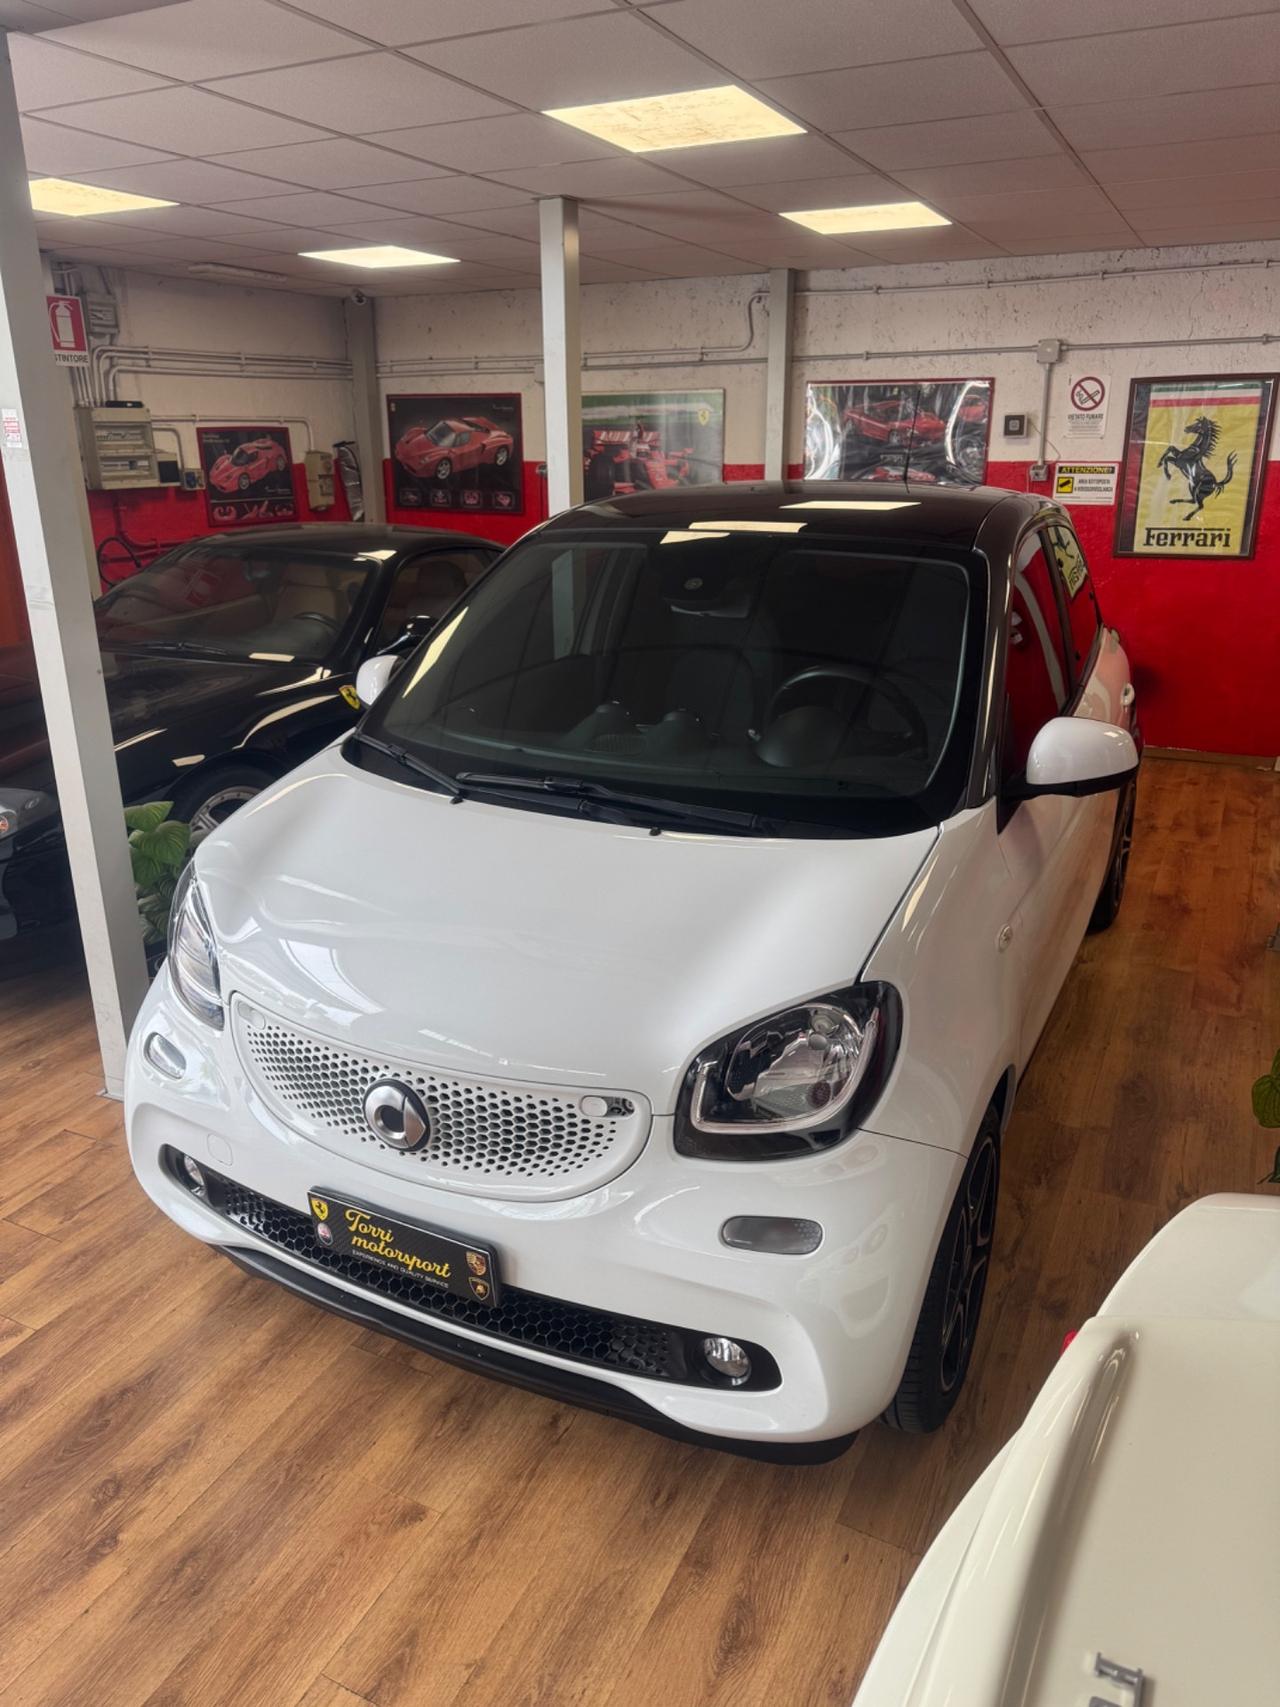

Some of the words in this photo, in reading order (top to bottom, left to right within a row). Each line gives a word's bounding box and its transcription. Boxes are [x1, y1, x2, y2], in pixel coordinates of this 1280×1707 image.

[1143, 527, 1231, 548] Ferrari
[345, 1209, 394, 1243] Torri
[351, 1235, 451, 1278] motorsport
[352, 1249, 386, 1266] EXPERIENCE
[387, 1260, 399, 1271] AND
[400, 1266, 424, 1278] QUALITY
[424, 1274, 449, 1288] SERVICE
